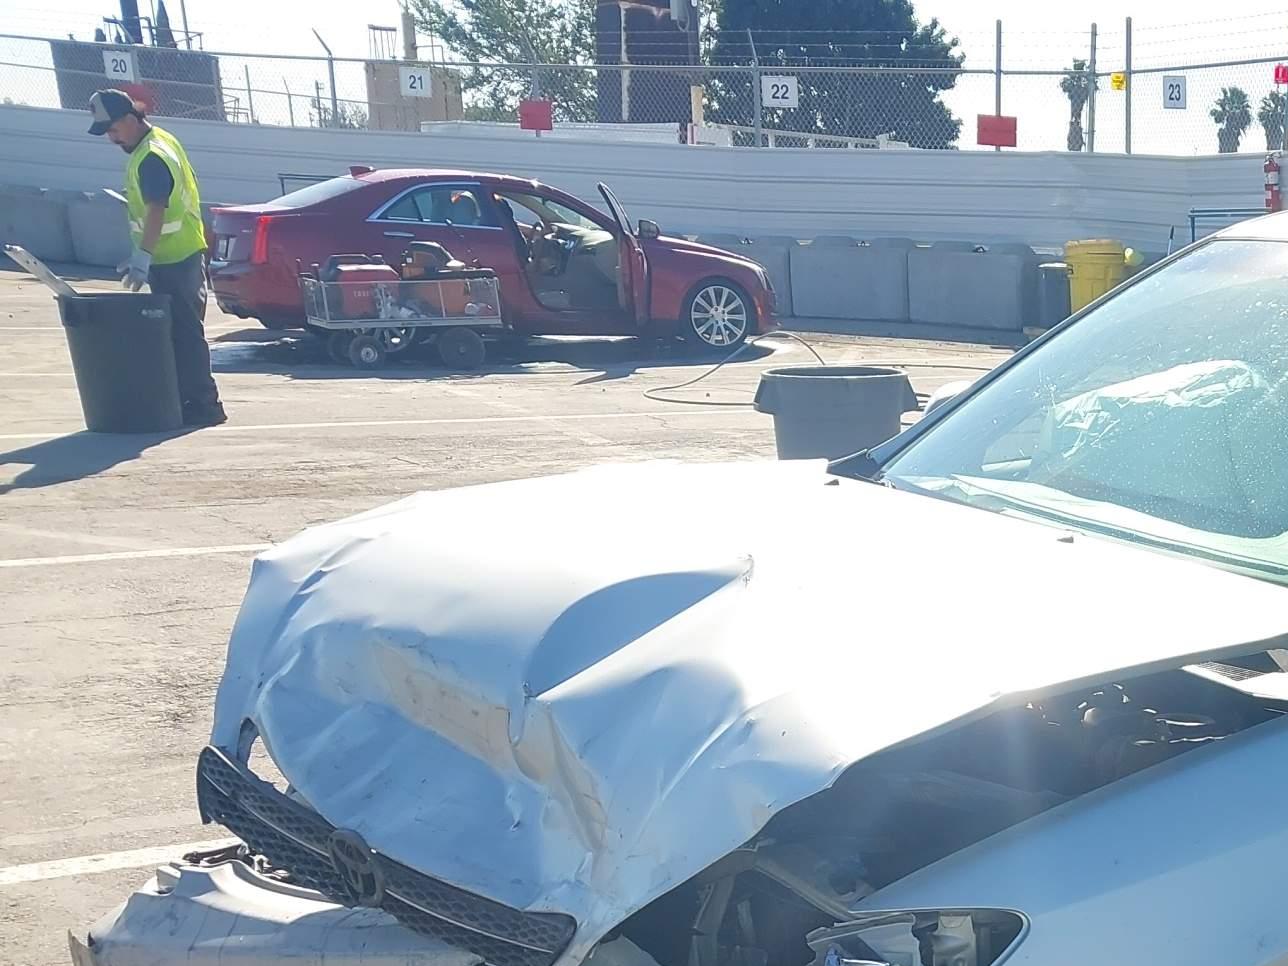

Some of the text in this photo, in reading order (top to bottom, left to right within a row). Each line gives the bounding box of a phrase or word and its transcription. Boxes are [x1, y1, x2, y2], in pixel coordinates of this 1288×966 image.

[111, 58, 127, 73] 20
[408, 74, 424, 90] 21
[770, 83, 790, 100] 22
[1168, 83, 1181, 101] 23
